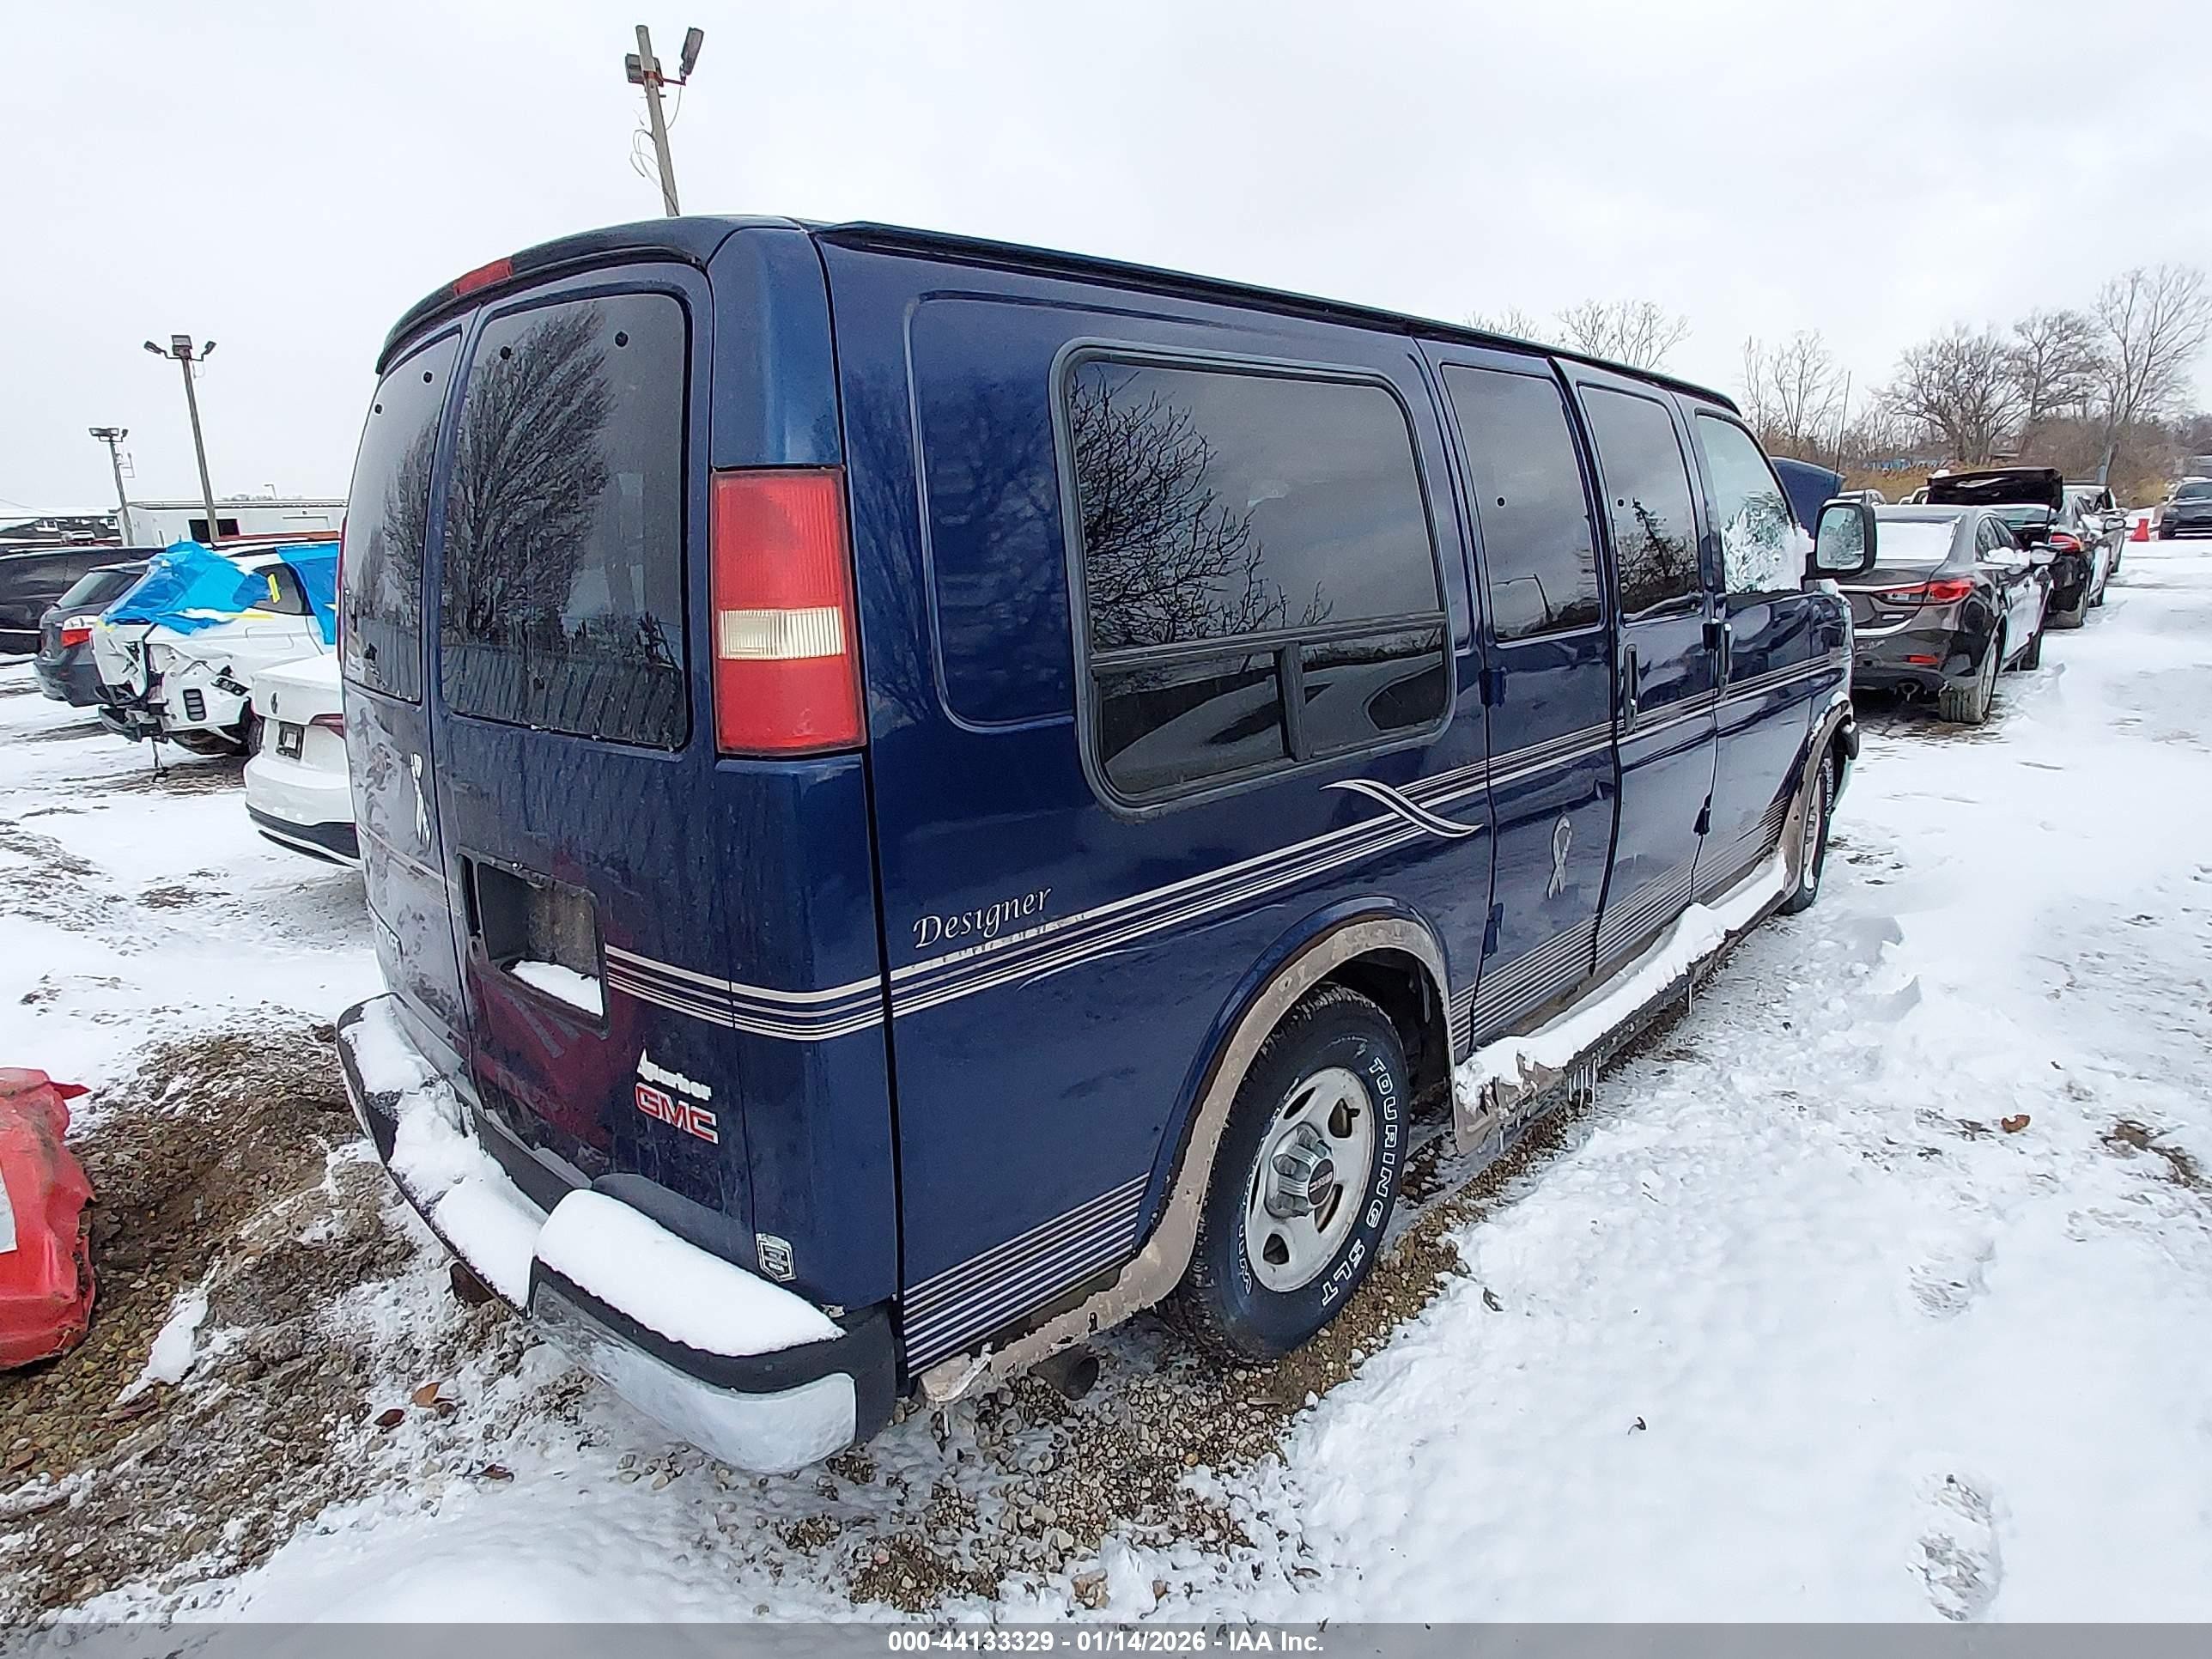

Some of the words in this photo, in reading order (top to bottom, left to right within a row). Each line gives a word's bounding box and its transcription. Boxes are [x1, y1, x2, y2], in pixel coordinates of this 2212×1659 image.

[912, 887, 1053, 948] Designer
[635, 1081, 719, 1145] GMC
[1366, 1055, 1399, 1229] TOURING
[1322, 1237, 1365, 1307] SLT
